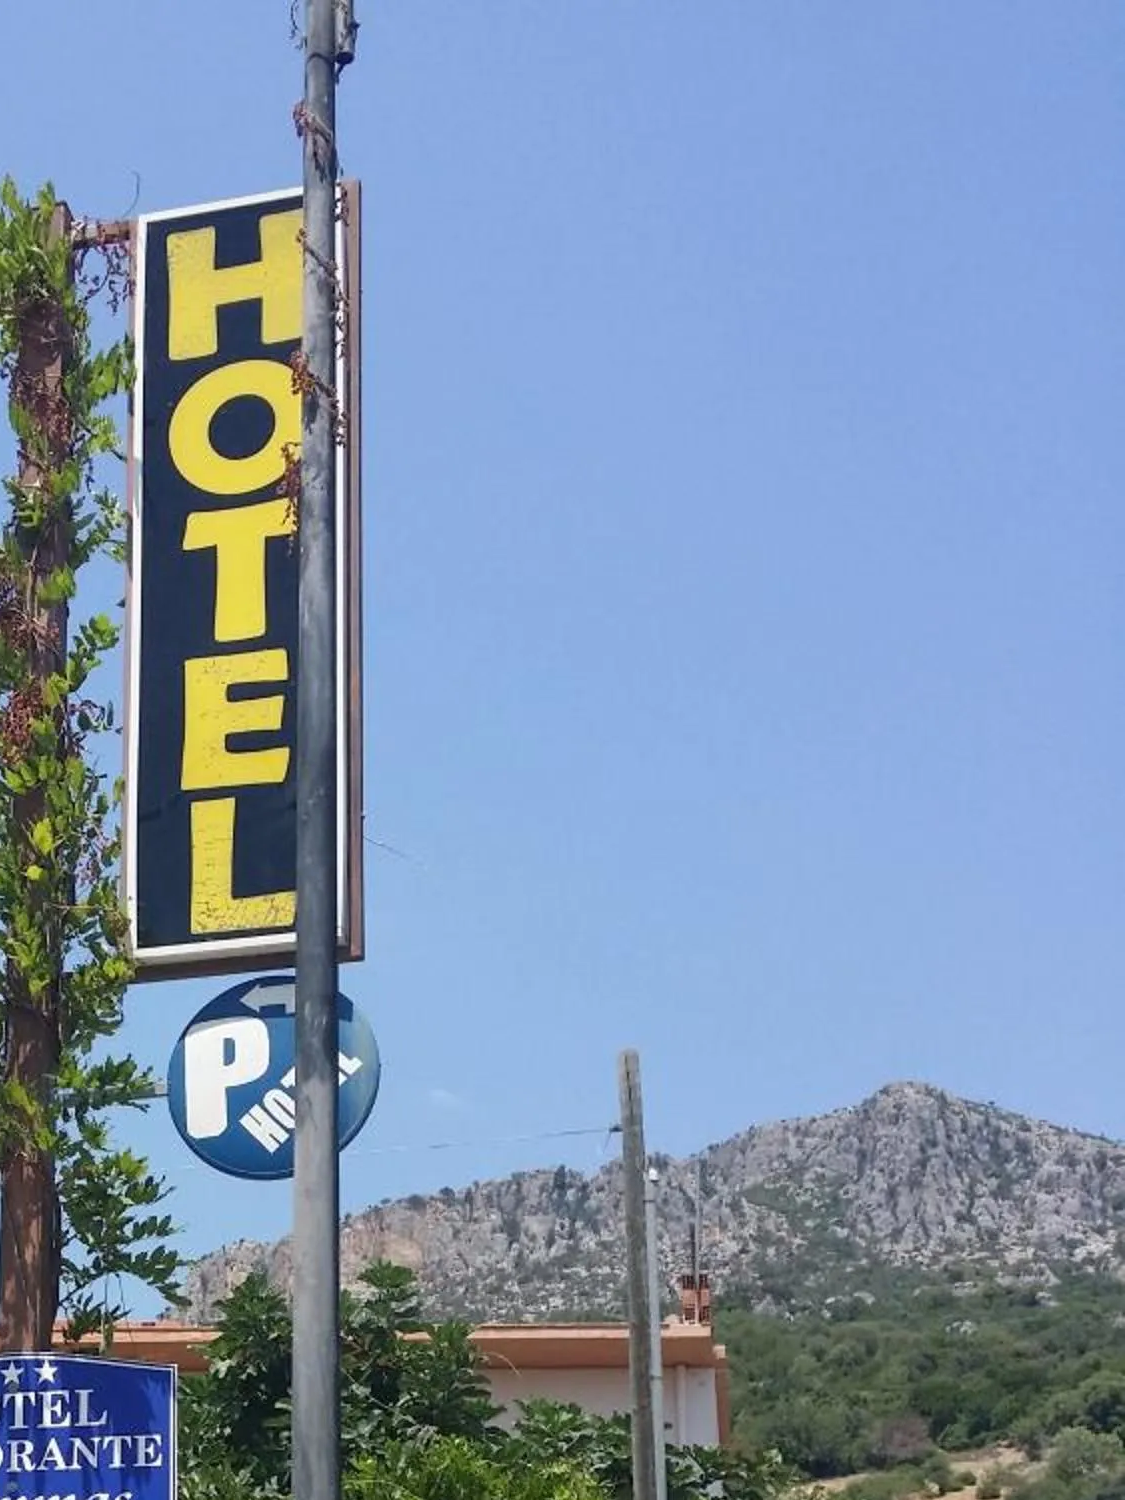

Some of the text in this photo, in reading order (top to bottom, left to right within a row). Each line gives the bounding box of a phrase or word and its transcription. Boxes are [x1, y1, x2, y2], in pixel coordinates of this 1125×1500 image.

[166, 207, 304, 935] HOTEL
[184, 1016, 269, 1139] P
[239, 1052, 363, 1154] HOL
